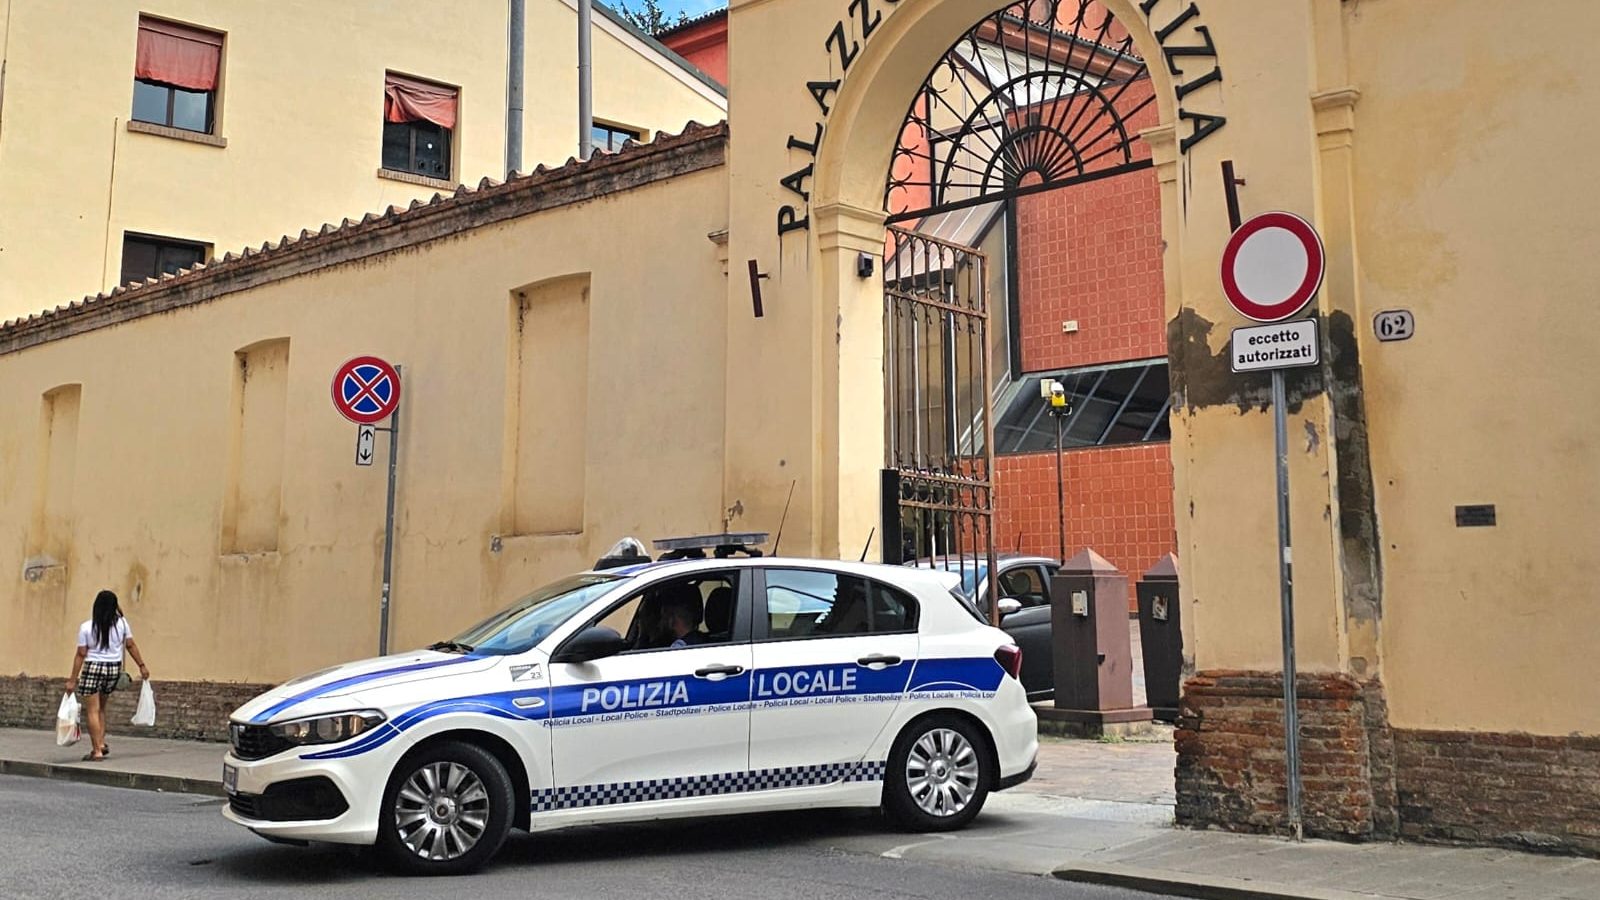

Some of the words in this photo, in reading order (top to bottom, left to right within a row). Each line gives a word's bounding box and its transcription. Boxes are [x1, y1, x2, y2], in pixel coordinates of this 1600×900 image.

[778, 0, 902, 236] PALAZZ
[1380, 315, 1406, 337] 62
[1248, 330, 1300, 346] eccetto
[1238, 345, 1312, 364] autorizzati
[530, 671, 541, 679] 23
[580, 680, 689, 712] POLIZIA
[758, 668, 857, 696] LOCALE
[543, 718, 570, 727] Policia
[572, 716, 594, 724] Local
[601, 713, 623, 722] Local
[624, 710, 648, 719] Police
[708, 704, 731, 713] Police
[764, 699, 788, 708] Policia
[790, 698, 808, 706] Local
[815, 696, 834, 704] Local
[836, 695, 857, 703] Police
[910, 692, 931, 700] Police
[932, 691, 954, 699] Locale
